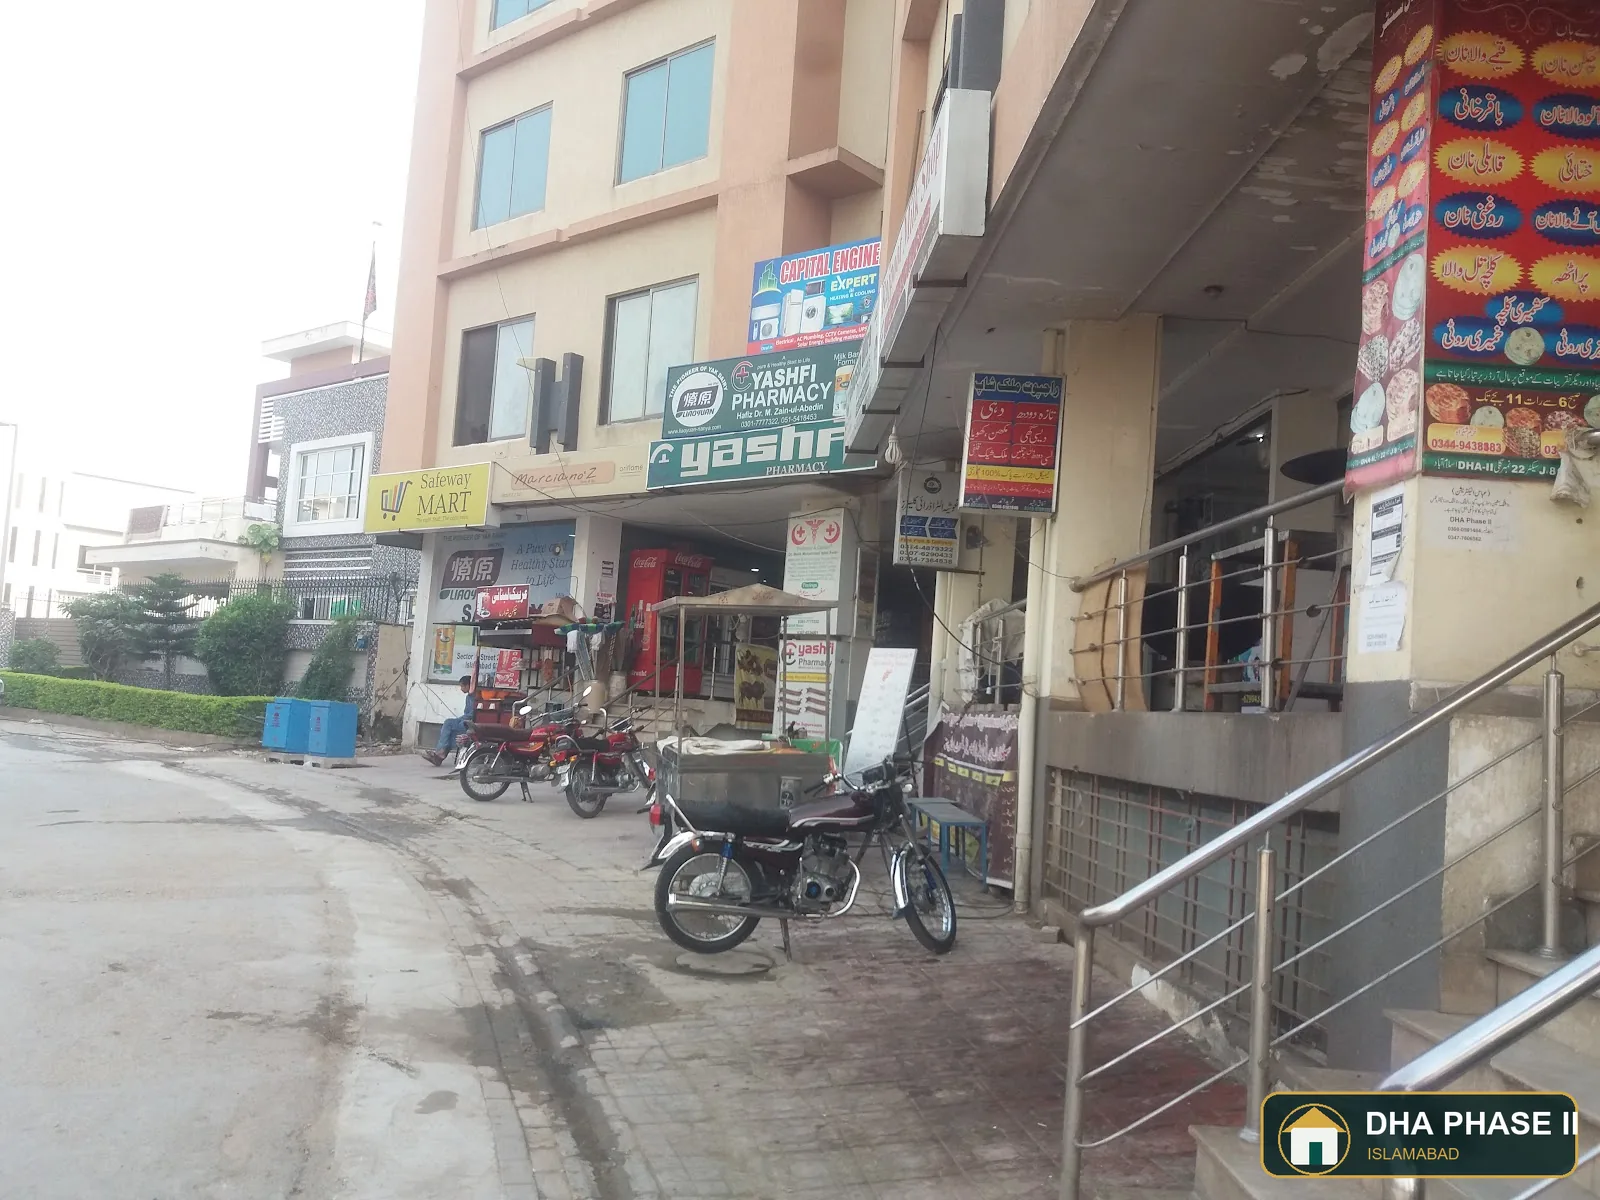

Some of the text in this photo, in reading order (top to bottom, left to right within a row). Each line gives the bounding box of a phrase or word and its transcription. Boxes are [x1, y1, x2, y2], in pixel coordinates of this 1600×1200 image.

[1446, 47, 1468, 63] نان
[1448, 141, 1506, 176] قابلی نان
[1444, 205, 1471, 227] نان
[1471, 194, 1504, 230] روغنی
[1535, 211, 1556, 230] نان
[780, 251, 831, 285] CAPITAL
[832, 241, 881, 275] ENGINE
[1442, 260, 1463, 278] والا
[831, 273, 877, 292] EXPERT
[855, 289, 876, 297] COOLING
[1511, 296, 1550, 324] کشمیری
[1441, 318, 1504, 352] خمیری روٹی
[834, 353, 846, 361] Milk
[669, 385, 677, 398] THE
[677, 367, 699, 384] PIONEER
[708, 367, 719, 376] YAK
[751, 364, 817, 390] YASHFI
[684, 390, 713, 408] 燎原
[732, 381, 833, 411] PHARMACY
[1475, 389, 1492, 402] تک
[1506, 393, 1522, 405] 11
[1524, 395, 1543, 406] رات
[1543, 399, 1558, 407] سے
[1559, 397, 1568, 408] 6
[1568, 392, 1581, 409] صبح
[737, 403, 824, 420] Hafiz Dr. M. Zain-ul-Abedin
[980, 402, 1005, 420] دہی
[766, 461, 828, 476] PHARMACY
[982, 469, 1001, 477] 100%
[1458, 461, 1494, 472] DHA-II
[1512, 465, 1525, 474] 22
[421, 471, 473, 490] Safeway
[417, 491, 472, 516] MART
[516, 544, 545, 555] A Pure
[451, 556, 495, 582] 燎原
[511, 559, 547, 572] Healthy
[526, 575, 556, 588] to Life
